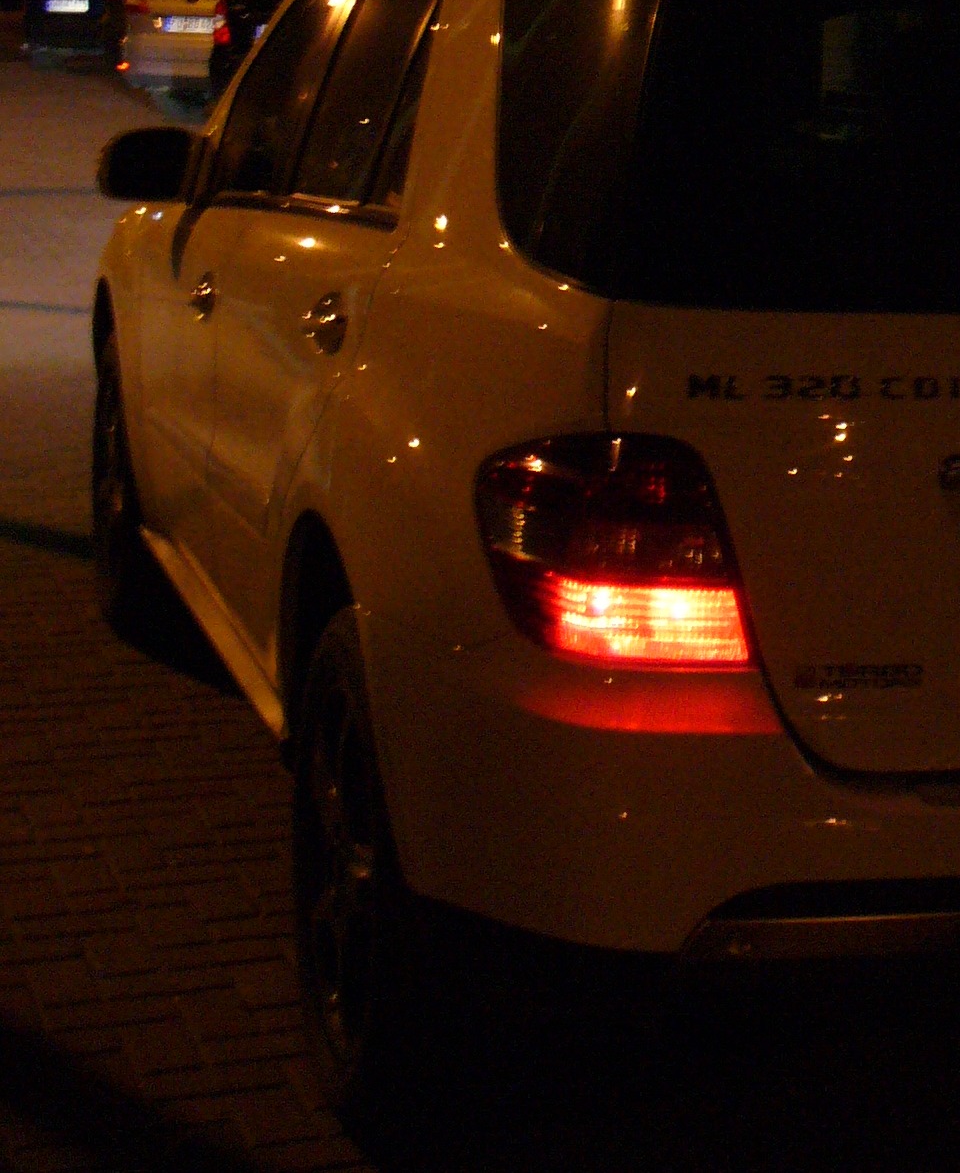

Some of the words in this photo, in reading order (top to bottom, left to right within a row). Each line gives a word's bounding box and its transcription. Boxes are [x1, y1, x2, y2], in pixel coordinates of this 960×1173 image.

[687, 374, 742, 401] ML
[765, 374, 860, 401] 320
[880, 376, 960, 400] CDI
